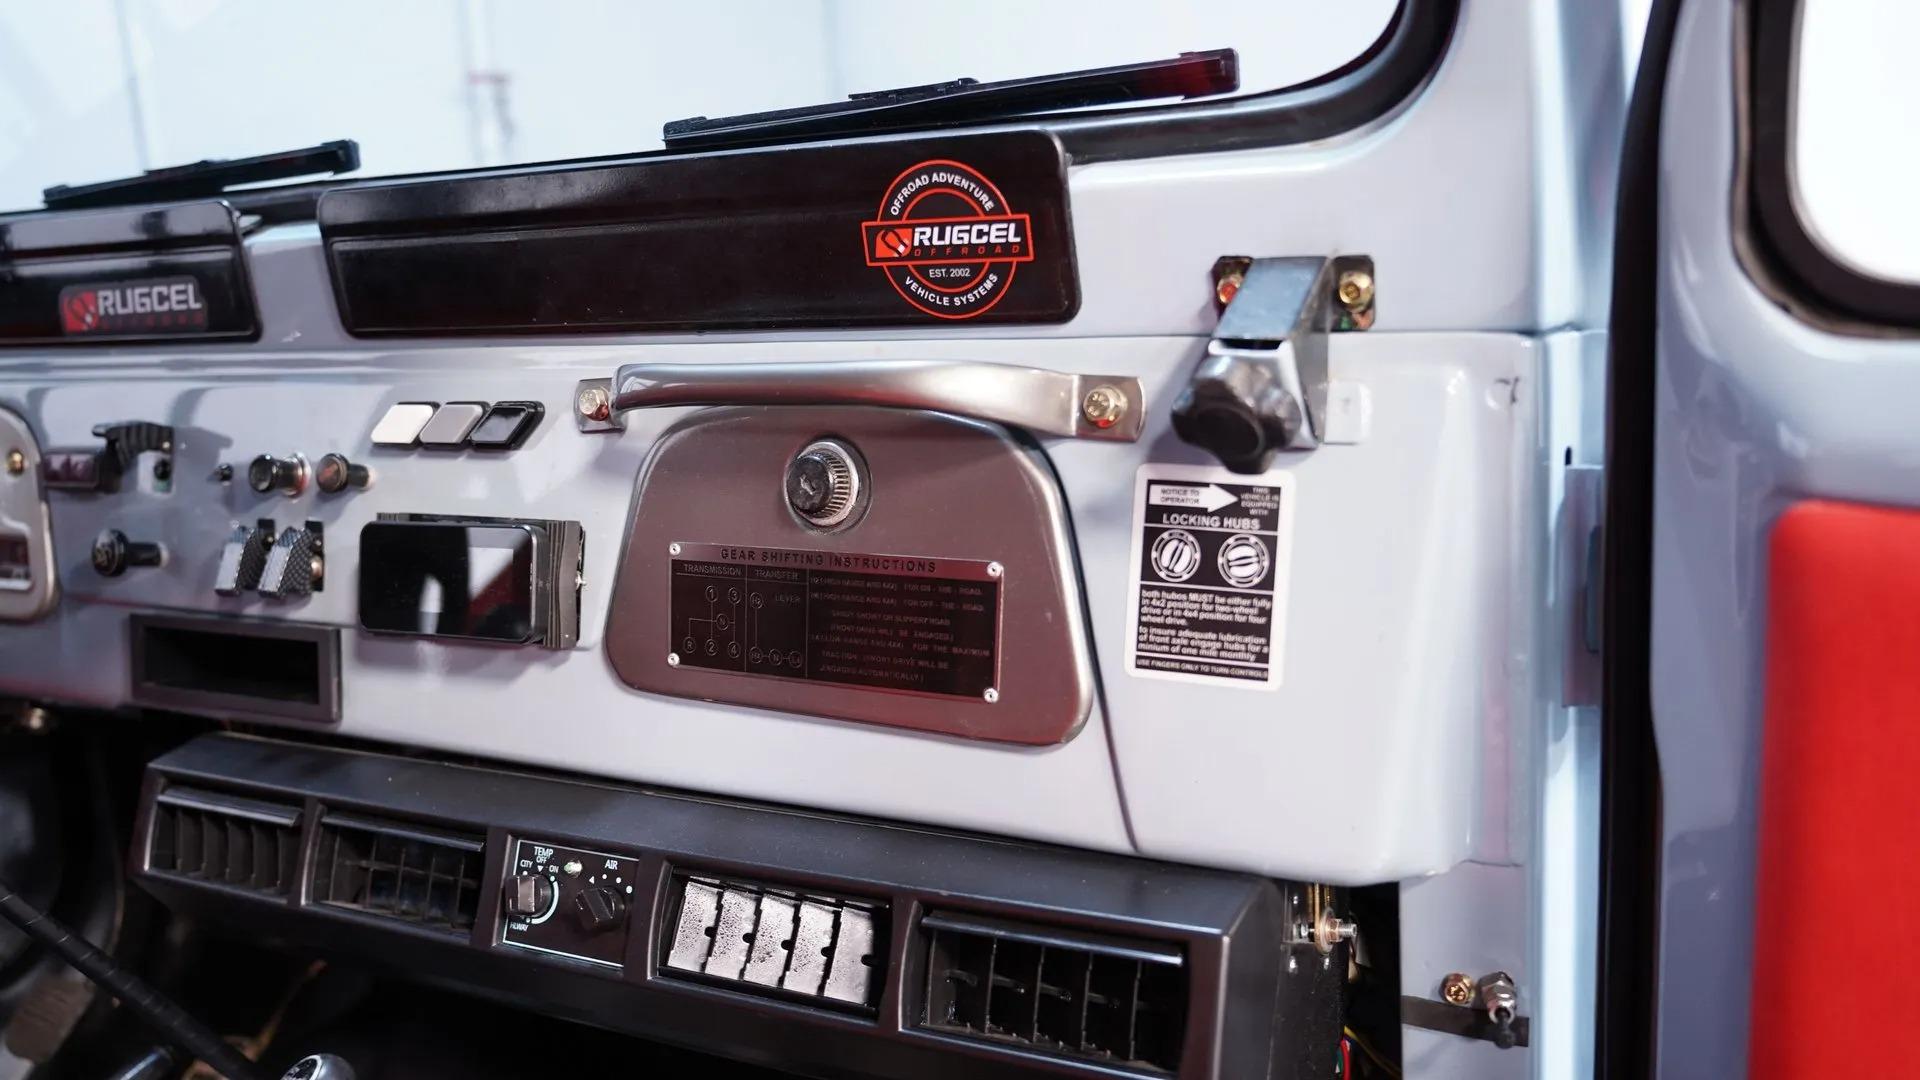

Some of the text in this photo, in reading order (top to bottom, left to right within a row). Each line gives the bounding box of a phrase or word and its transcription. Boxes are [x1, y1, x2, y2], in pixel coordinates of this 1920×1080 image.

[891, 172, 995, 216] OFFROAD ADVENTURE
[913, 223, 1021, 246] RUGCEL
[929, 268, 970, 278] EST. 2002
[905, 273, 998, 306] VEHICLE SYSTEMS
[98, 283, 202, 316] RUGCEL
[1162, 513, 1261, 530] LOCKING HUBS
[721, 548, 937, 573] GEAR SHIFTING INSTRUCTIONS
[684, 564, 742, 576] TRANSMISSION
[1141, 589, 1160, 599] both
[1188, 593, 1214, 603] MUST
[1214, 595, 1225, 604] be
[1227, 596, 1251, 606] either
[1252, 598, 1272, 611] fully
[1152, 598, 1166, 608] 4x2
[1167, 600, 1201, 611] position
[1202, 602, 1214, 611] for
[1140, 614, 1164, 624] wheel
[1141, 606, 1161, 615] drive
[1183, 610, 1198, 618] 4x4
[1199, 611, 1233, 622] position
[1234, 614, 1247, 623] for
[1248, 614, 1267, 624] four
[1138, 633, 1148, 642] of
[1149, 635, 1170, 644] front
[1171, 636, 1189, 646] axle
[1190, 639, 1222, 651] engage
[1223, 641, 1246, 652] hubs
[1247, 643, 1261, 654] for
[1149, 627, 1177, 636] insure
[1178, 629, 1218, 641] adequate
[1218, 632, 1268, 645] lubrication
[1171, 644, 1181, 653] of
[1182, 646, 1198, 656] one
[1219, 650, 1256, 662] monthly
[534, 846, 554, 858] TEMP
[536, 856, 547, 864] OFF
[520, 860, 533, 868] CITY
[549, 865, 559, 873] ON
[605, 860, 618, 870] AIR
